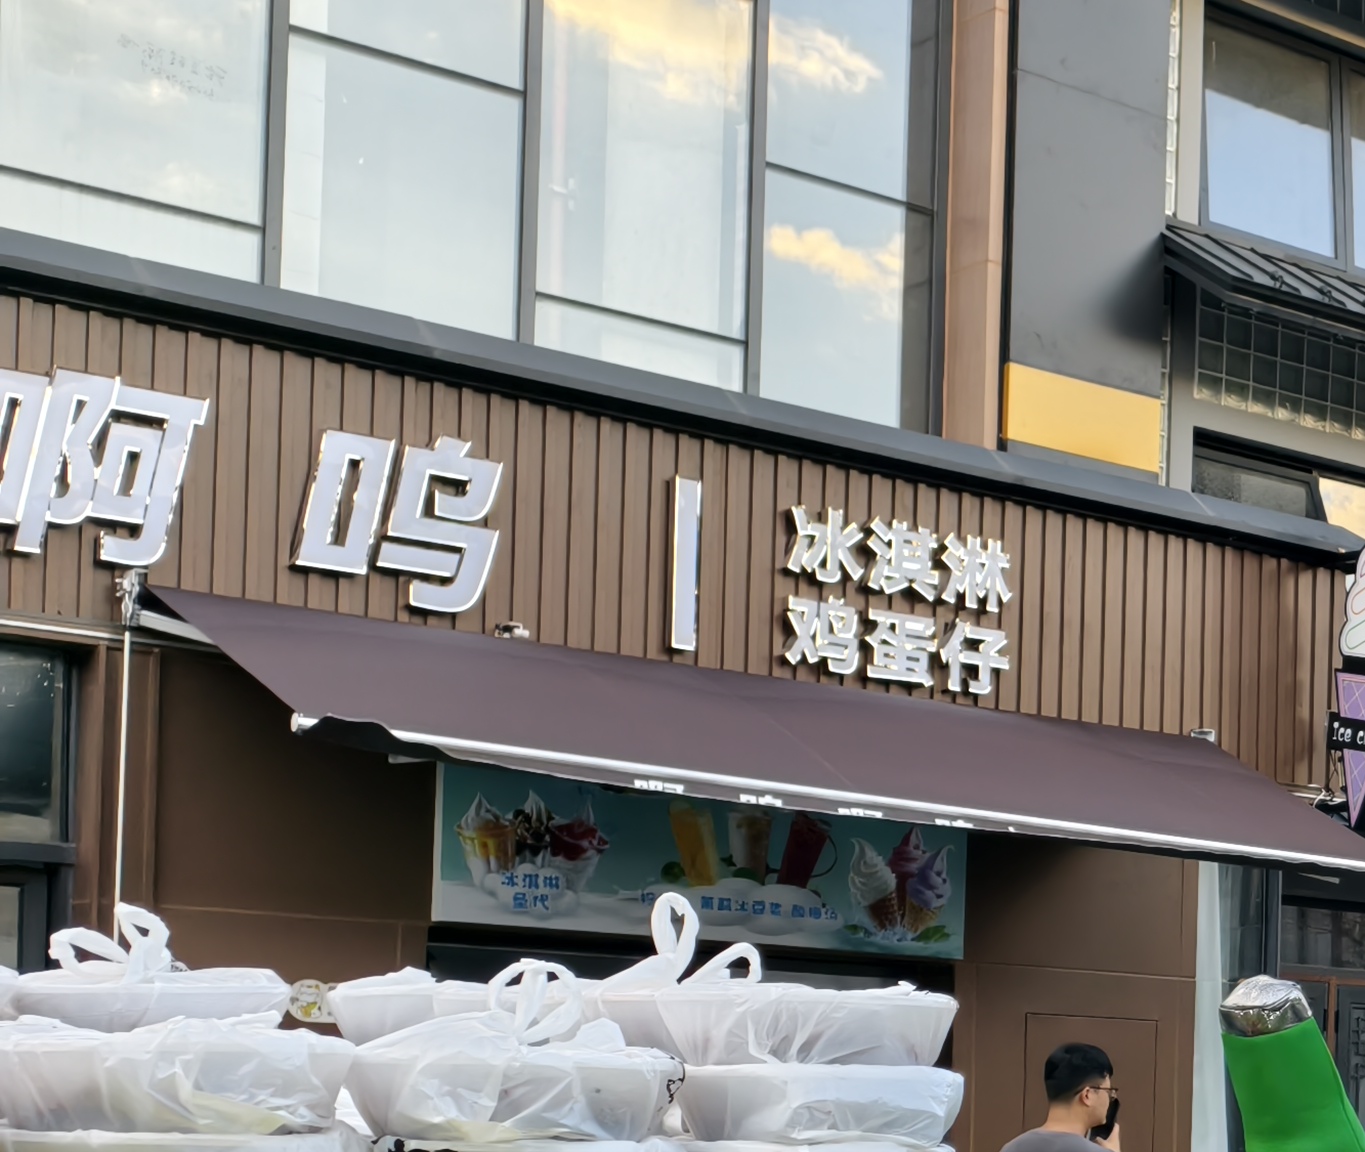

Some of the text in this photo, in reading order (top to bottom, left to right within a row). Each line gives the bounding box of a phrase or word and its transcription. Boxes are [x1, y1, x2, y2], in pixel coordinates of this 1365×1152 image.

[786, 505, 1012, 613] 冰淇淋
[784, 594, 1010, 695] 鸡蛋仔
[1332, 721, 1353, 744] Ice
